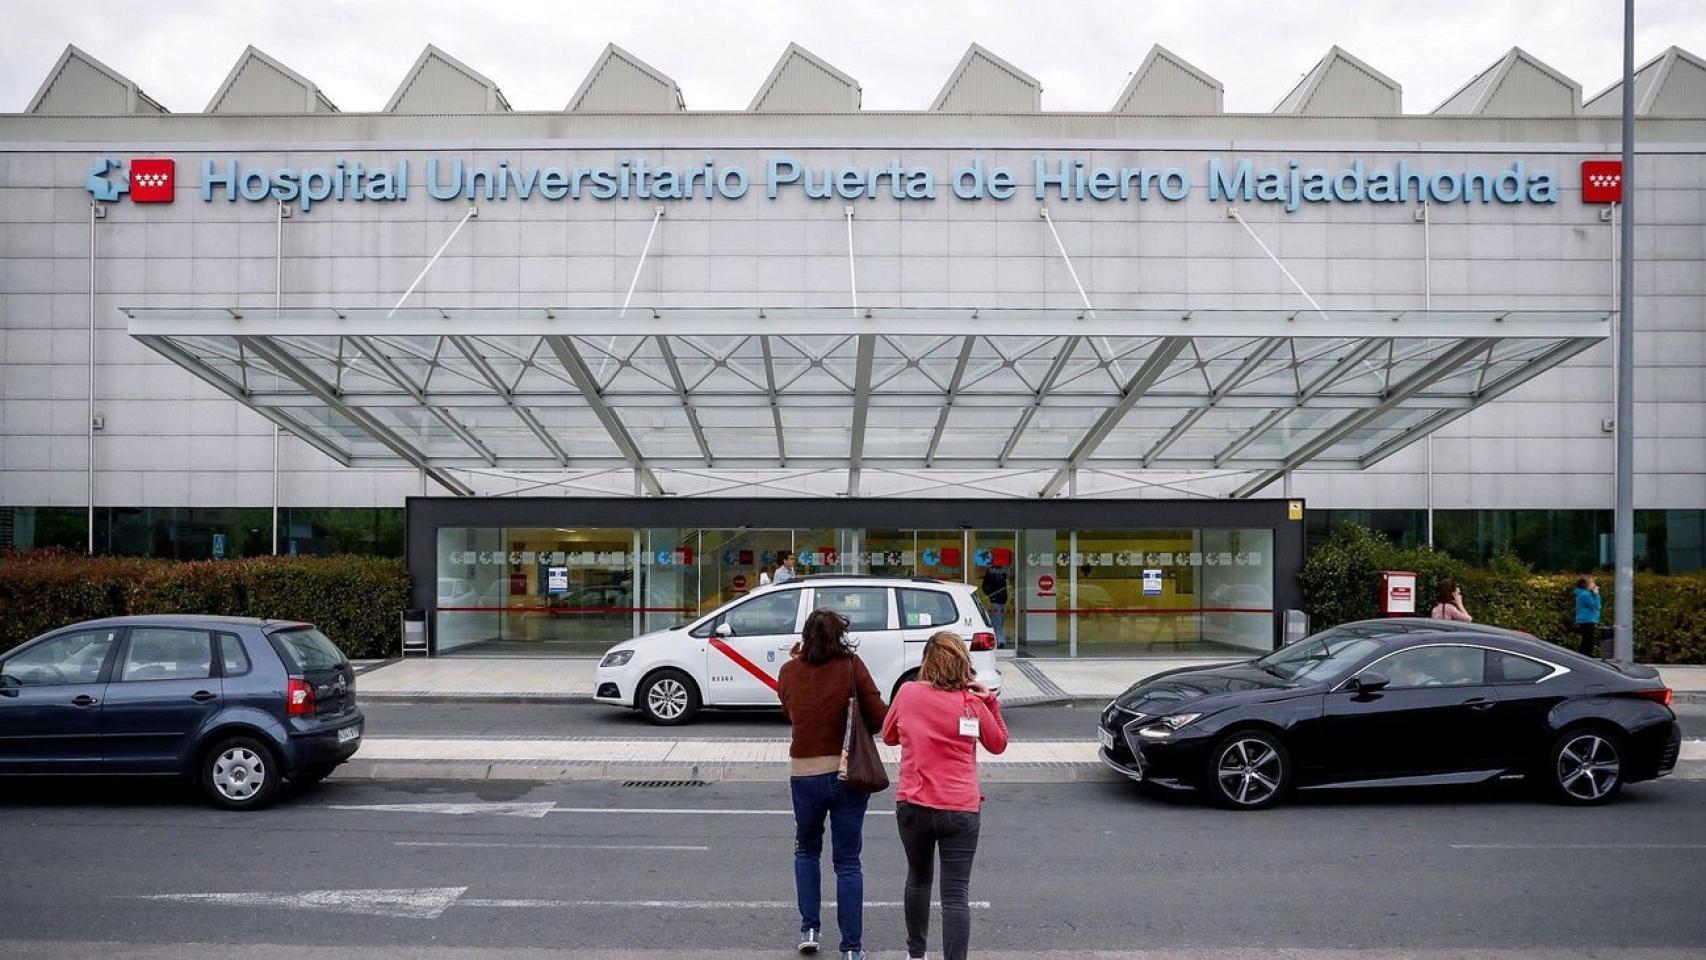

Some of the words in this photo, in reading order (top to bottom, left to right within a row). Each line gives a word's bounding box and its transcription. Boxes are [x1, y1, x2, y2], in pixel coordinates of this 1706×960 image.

[202, 158, 410, 211] Hospital
[427, 157, 751, 201] Universitario
[768, 156, 936, 202] Puerta
[953, 157, 1018, 202] de
[1035, 157, 1192, 202] Hierro
[1208, 158, 1558, 211] Majadahonda
